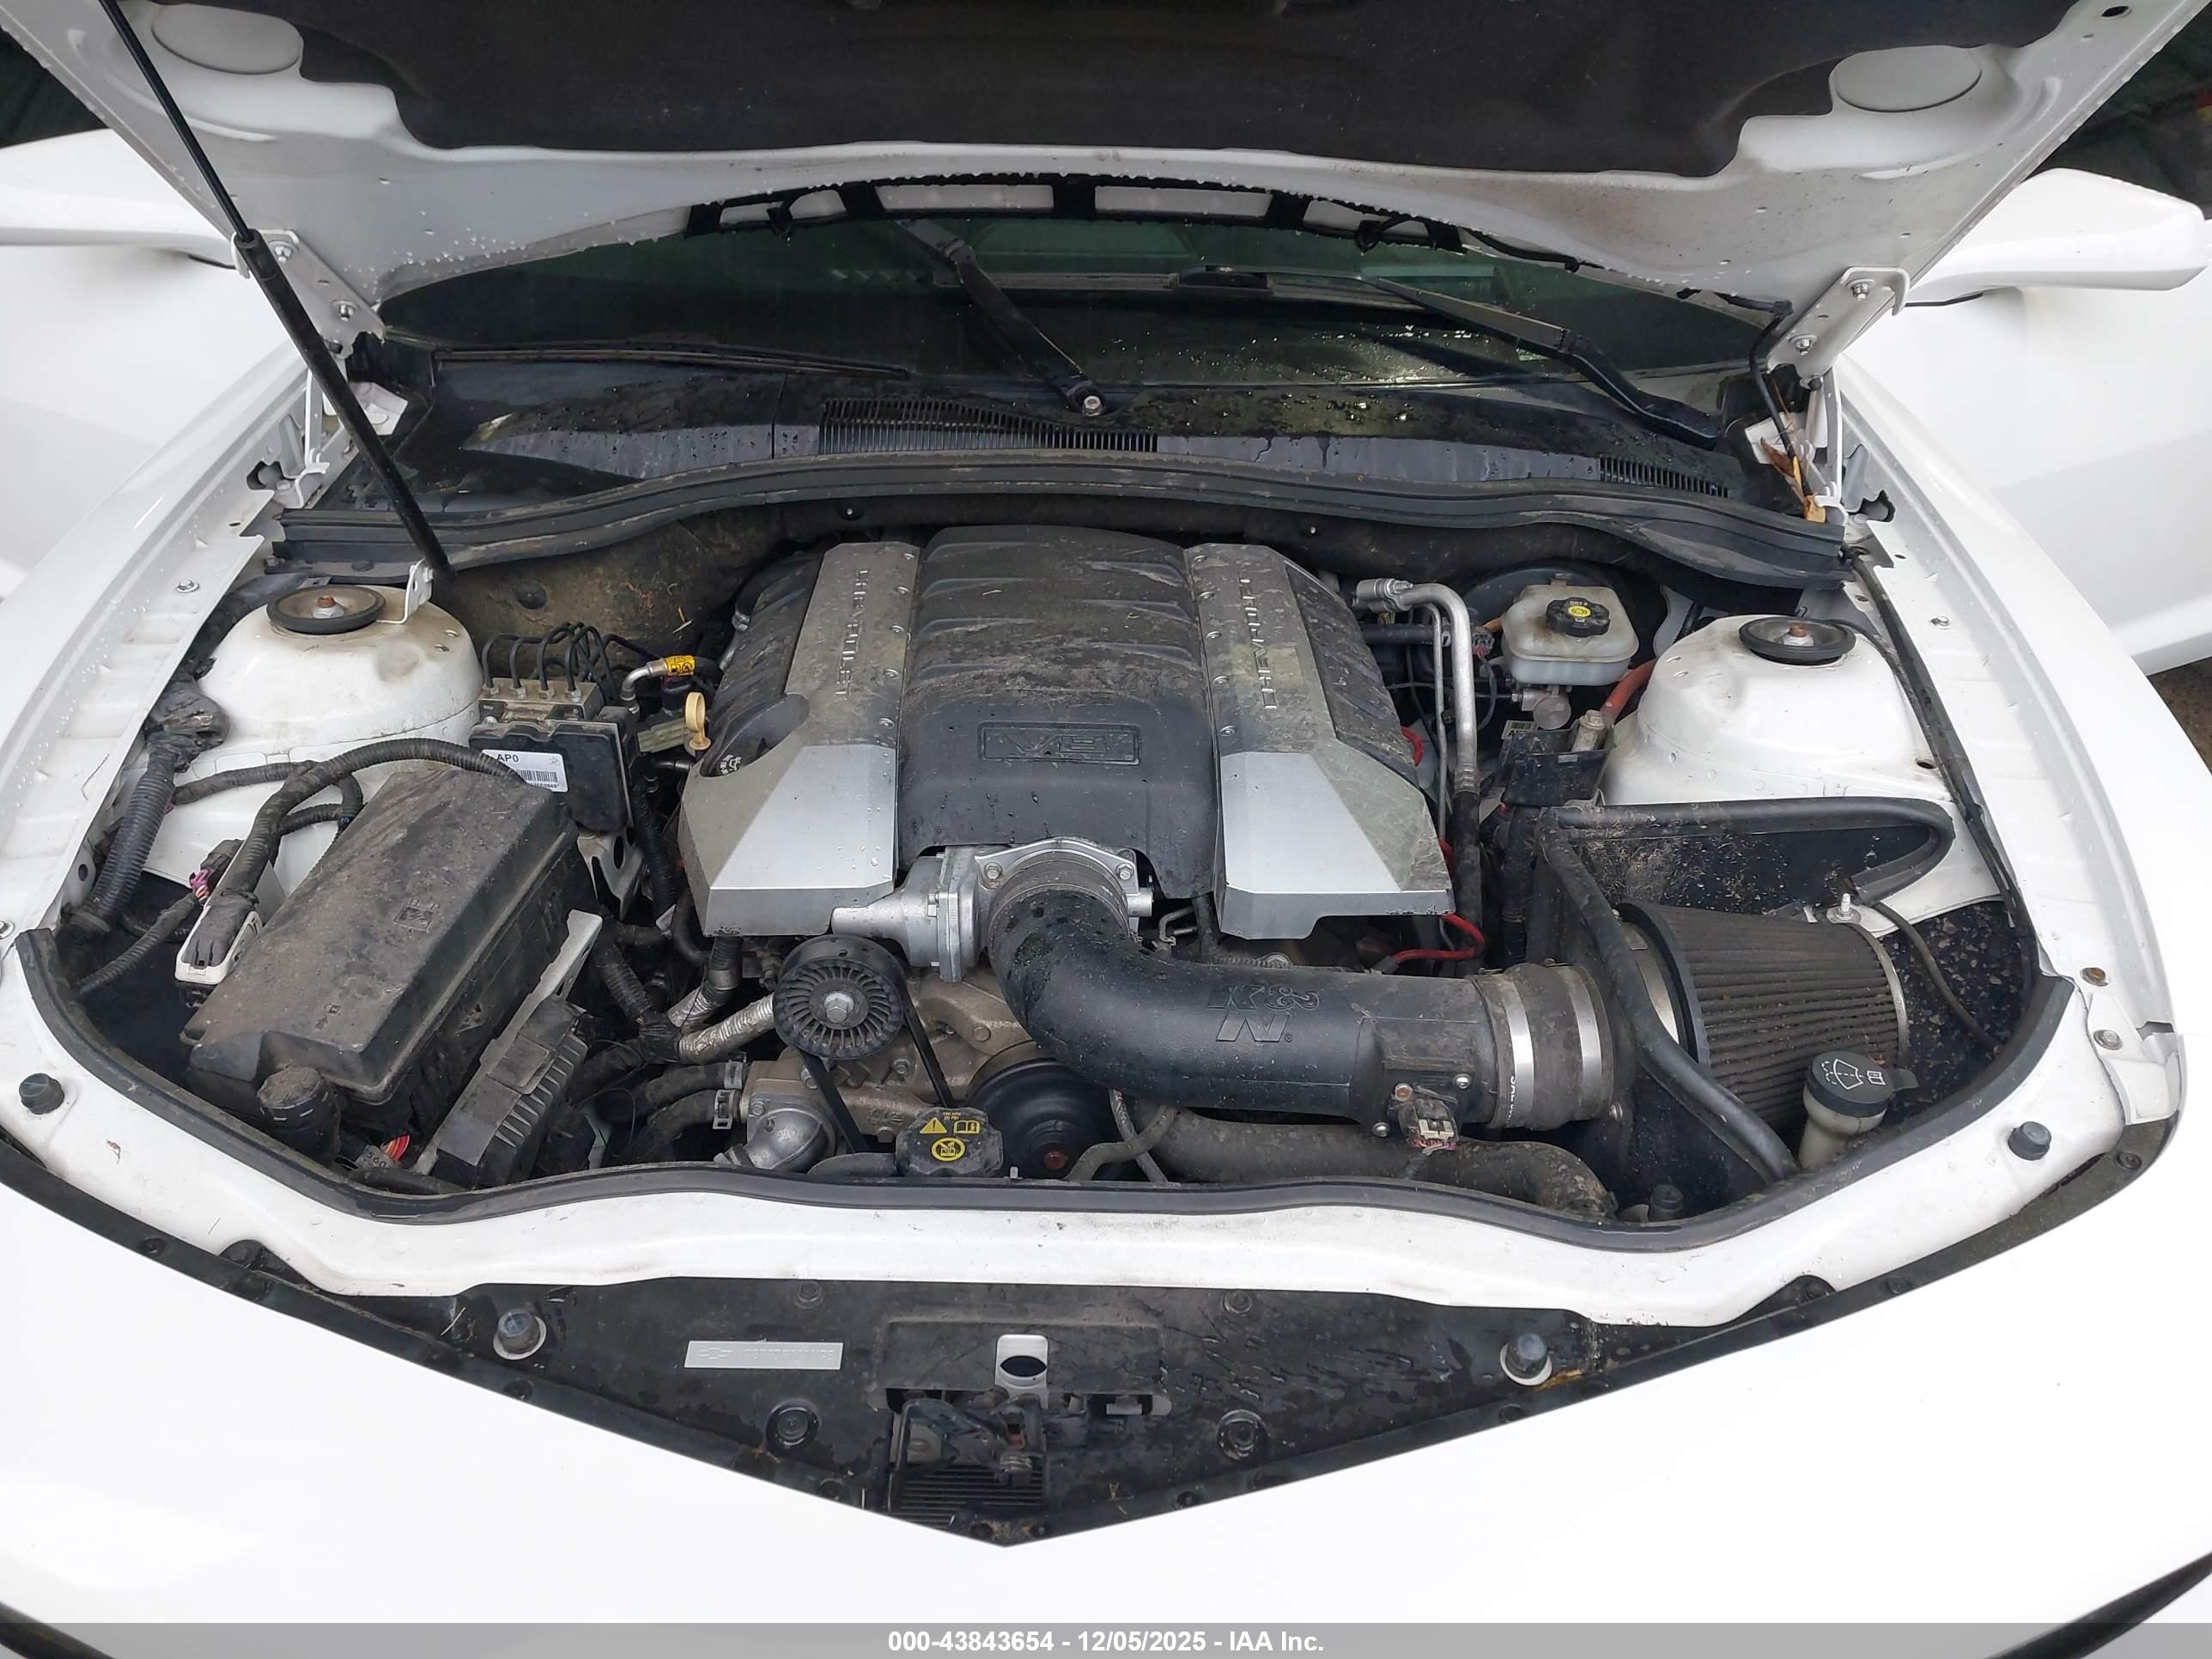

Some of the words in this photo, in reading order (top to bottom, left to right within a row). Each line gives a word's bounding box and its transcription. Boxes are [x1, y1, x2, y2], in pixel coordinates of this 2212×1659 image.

[831, 567, 870, 702] CHEVROLET
[1237, 570, 1279, 709] CHEVROLET
[1004, 732, 1109, 755] V8
